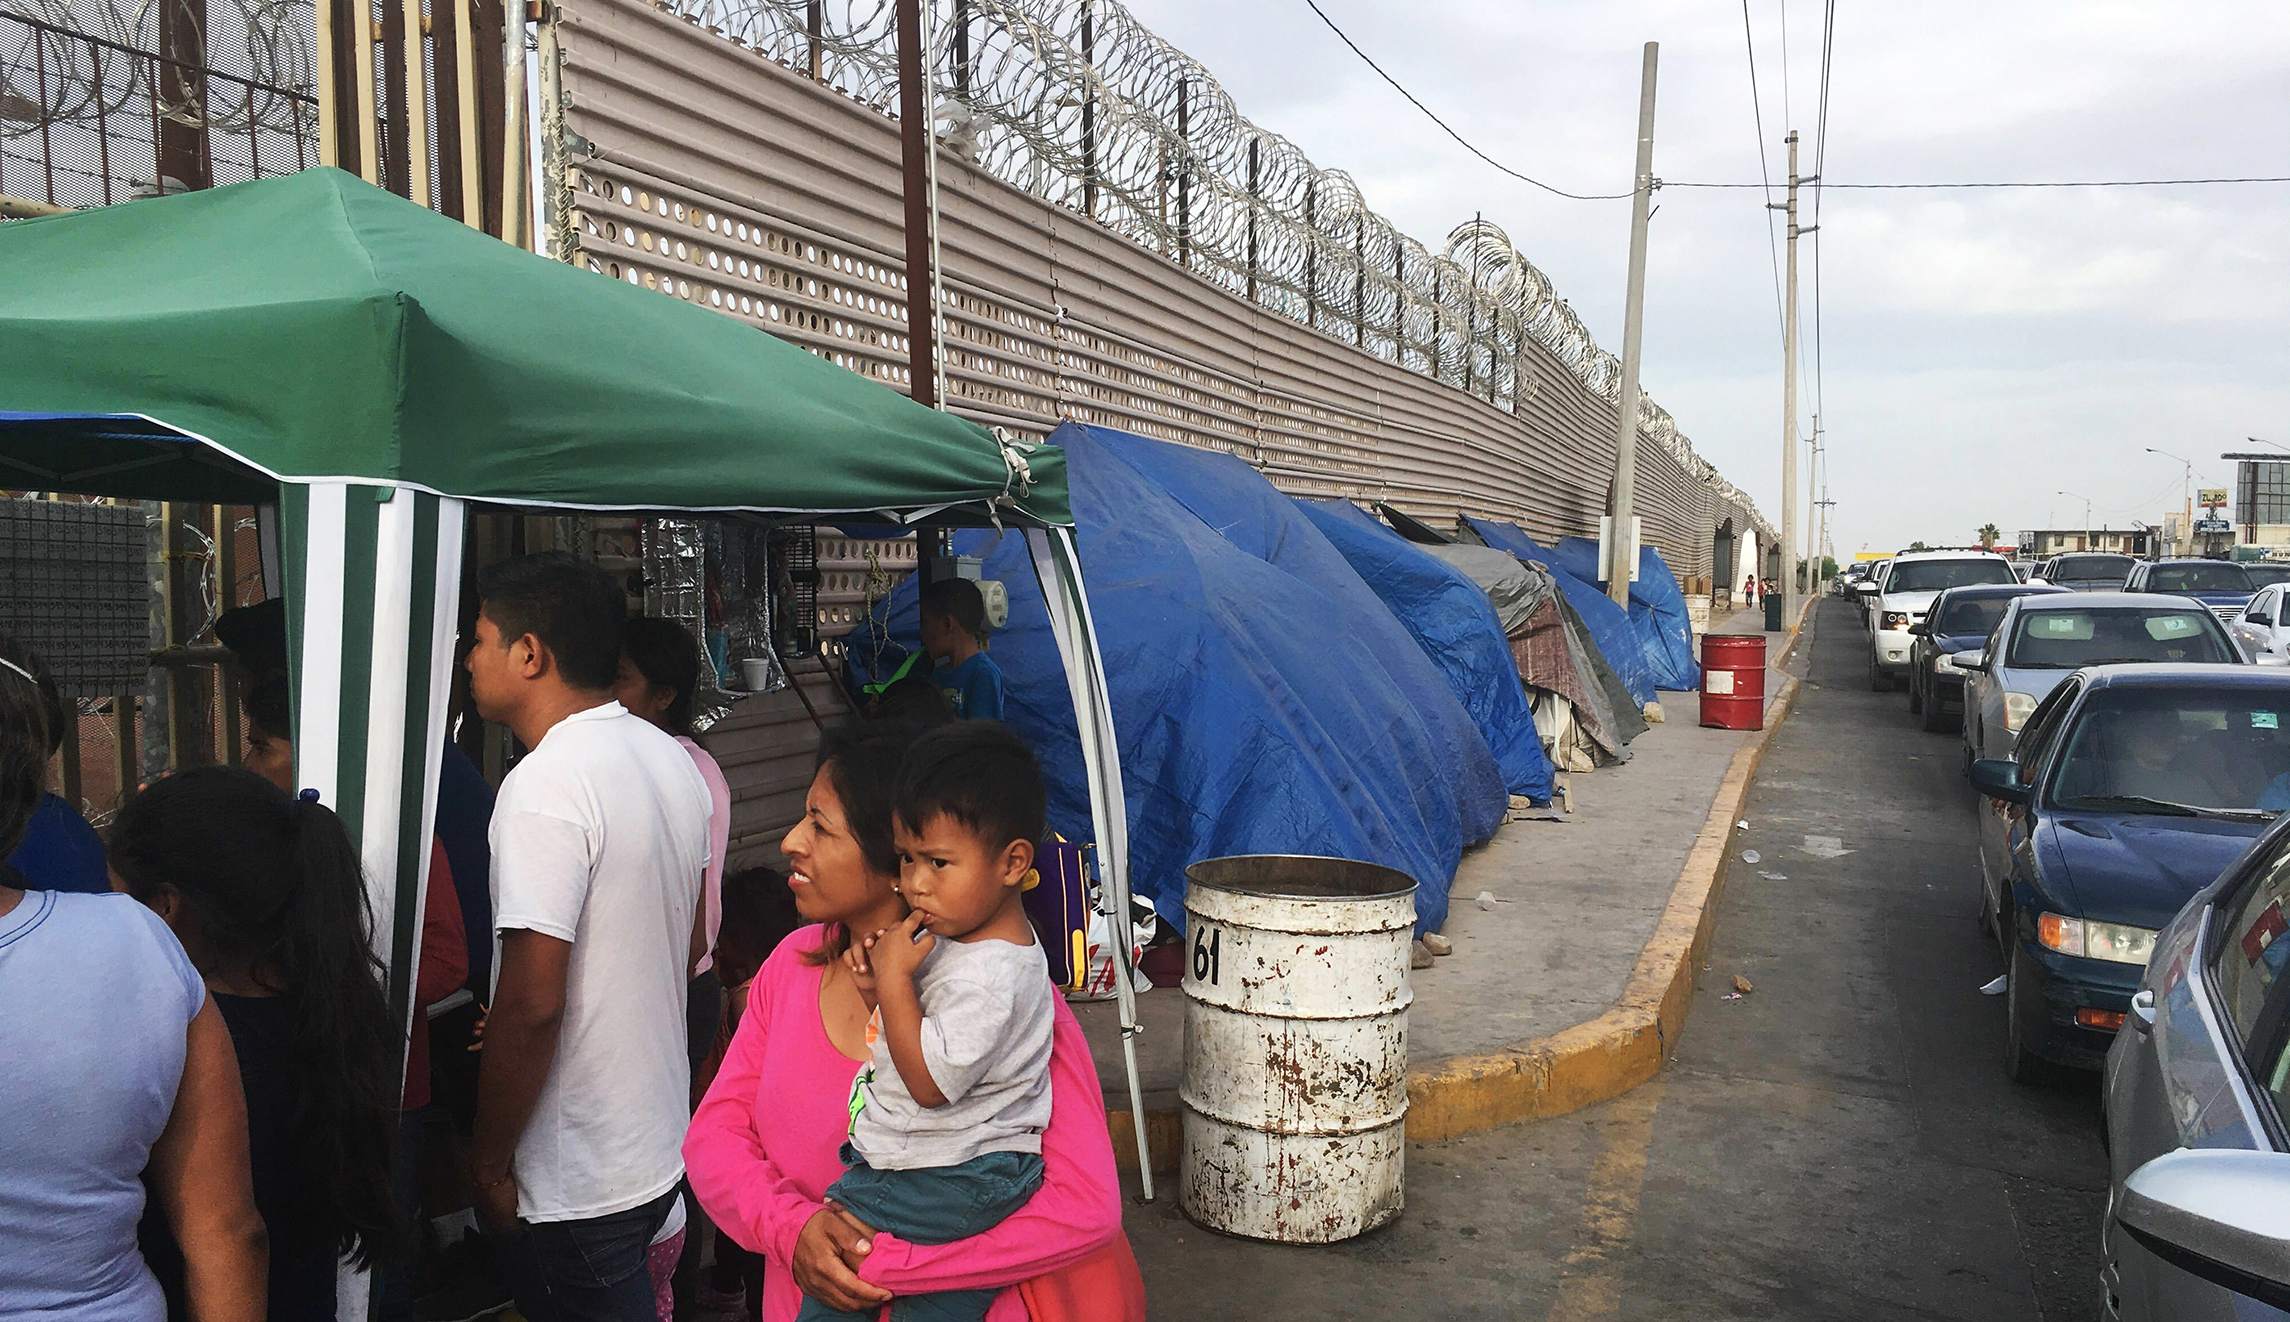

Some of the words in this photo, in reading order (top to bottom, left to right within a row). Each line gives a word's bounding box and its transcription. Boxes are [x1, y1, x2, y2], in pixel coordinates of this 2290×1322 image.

[129, 510, 143, 521] 300
[17, 601, 31, 610] 393
[34, 601, 47, 609] 394
[50, 601, 64, 610] 395
[67, 601, 80, 610] 396
[83, 601, 97, 610] 397
[99, 602, 112, 611] 398
[114, 603, 127, 611] 399
[129, 603, 145, 612] 400
[130, 621, 145, 630] 420
[99, 640, 113, 648] 438
[131, 659, 145, 668] 460
[128, 677, 144, 687] 480
[1193, 925, 1221, 985] 61
